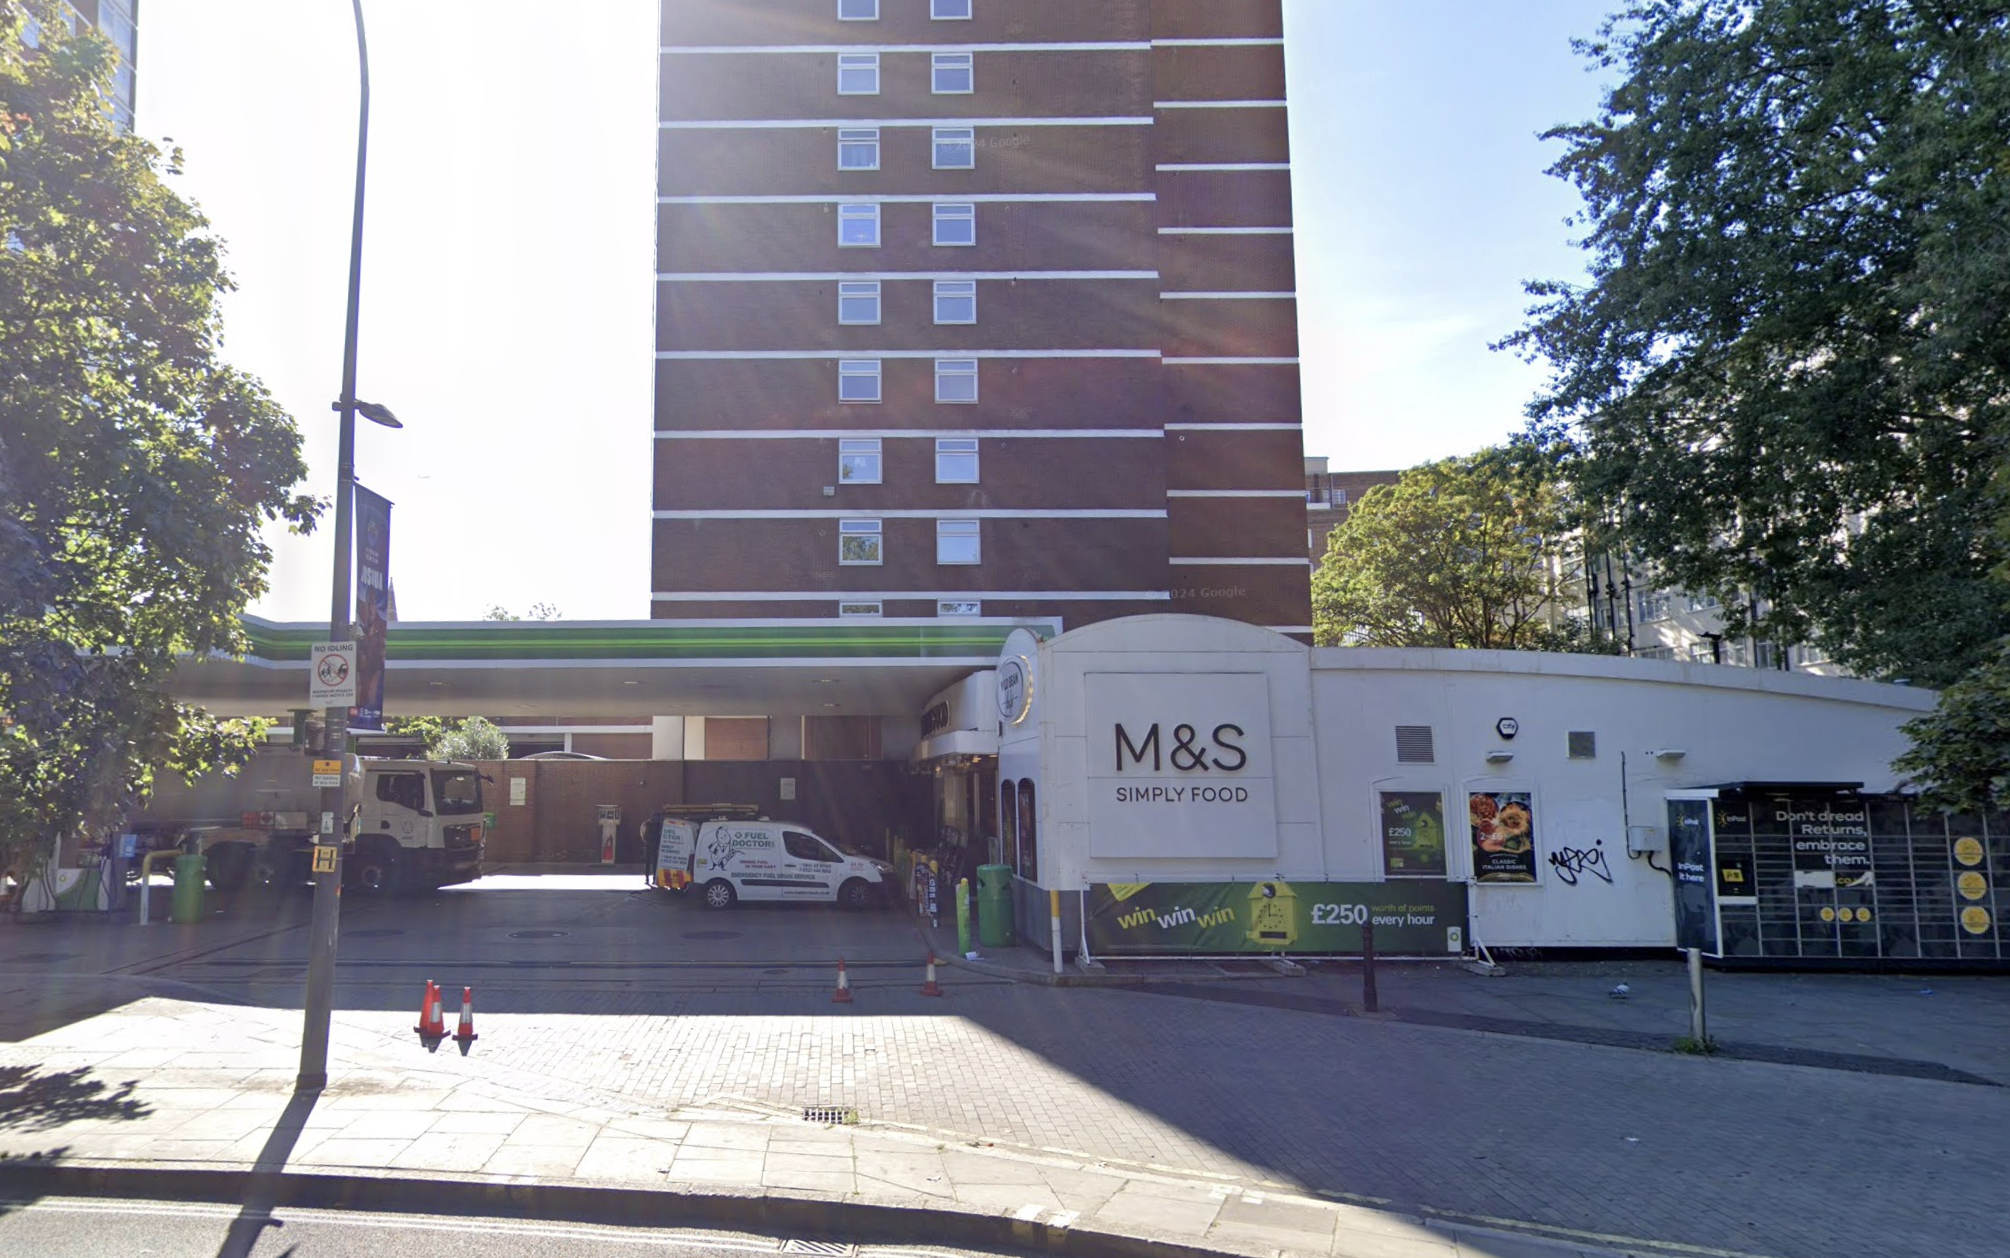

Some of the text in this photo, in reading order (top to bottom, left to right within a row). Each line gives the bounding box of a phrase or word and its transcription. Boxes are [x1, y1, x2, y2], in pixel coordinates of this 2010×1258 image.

[1115, 723, 1247, 771] M&S
[1116, 787, 1248, 802] SIMPLY FOOD
[1394, 804, 1410, 814] win
[1776, 811, 1864, 821] Don't dread
[1388, 827, 1412, 838] £250
[1801, 824, 1867, 836] Returns,
[1796, 840, 1866, 850] embrace
[1824, 854, 1871, 865] them.
[1678, 862, 1704, 872] InPost
[1686, 872, 1704, 882] here
[1311, 903, 1368, 925] £250
[1372, 904, 1435, 914] worth of points
[1117, 906, 1236, 929] win win win
[1372, 913, 1435, 927] every hour
